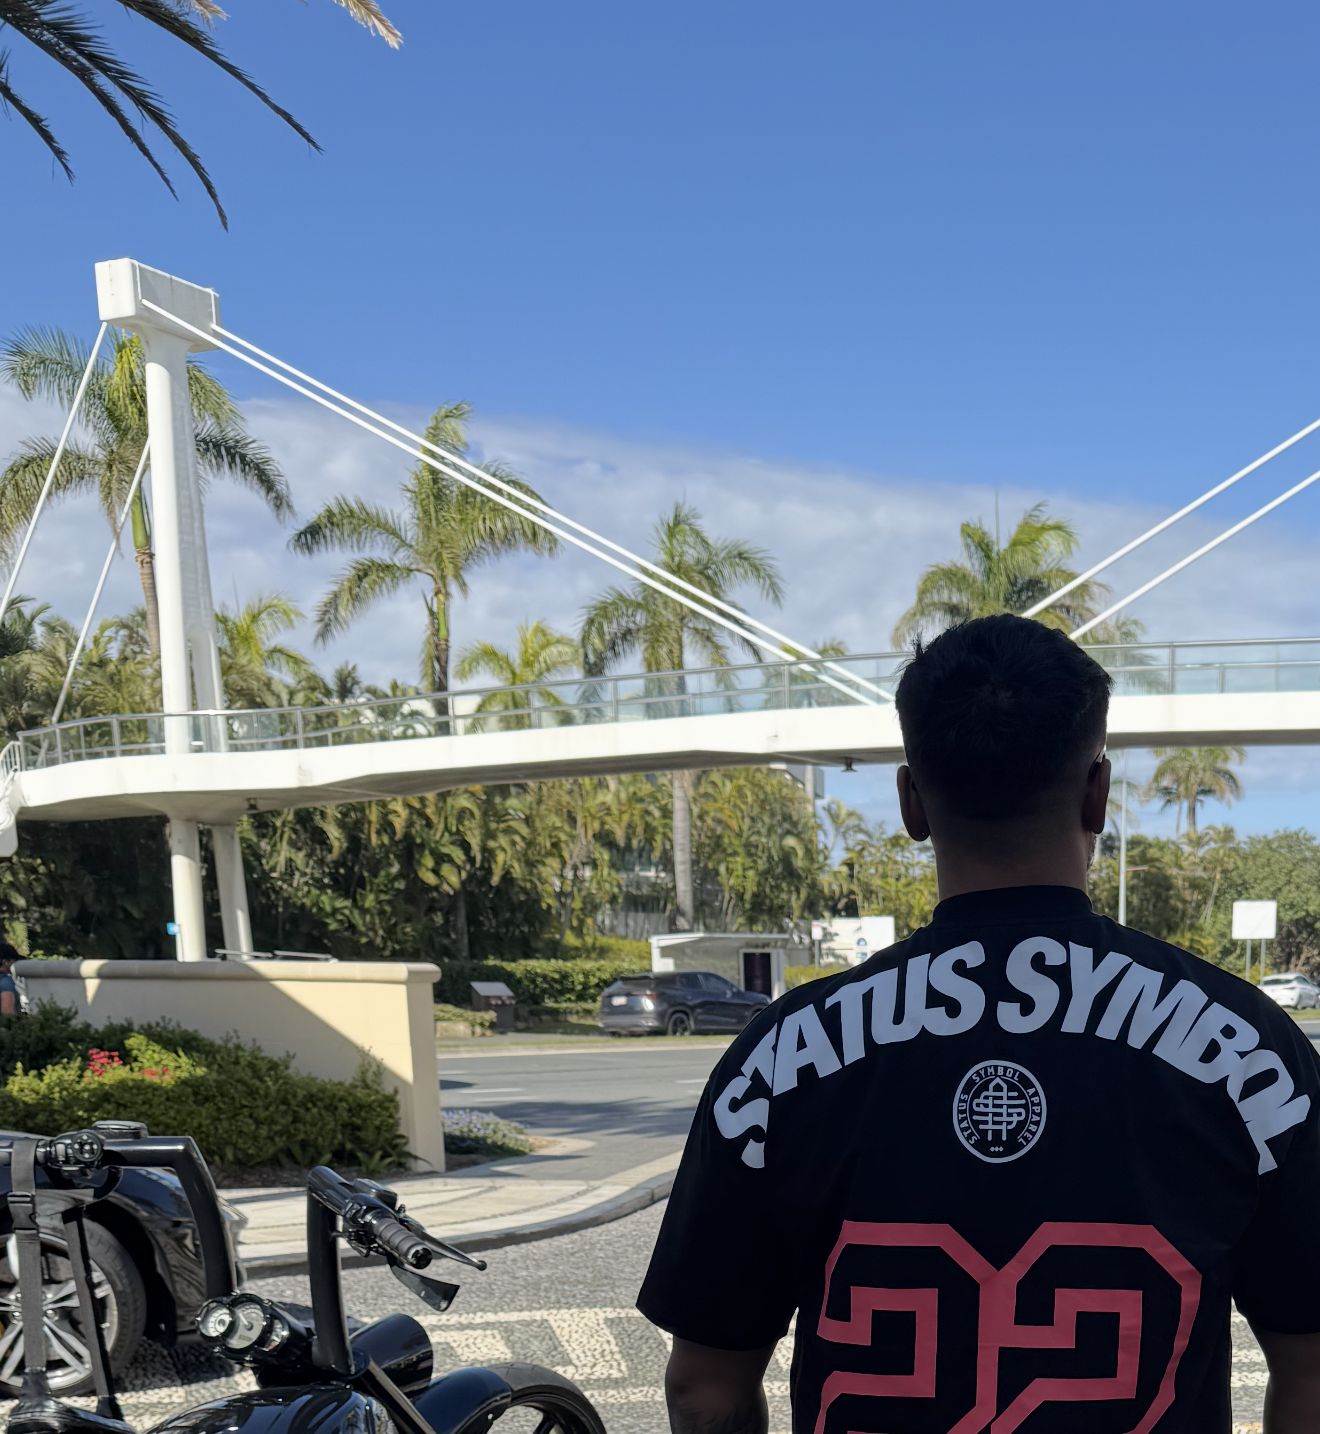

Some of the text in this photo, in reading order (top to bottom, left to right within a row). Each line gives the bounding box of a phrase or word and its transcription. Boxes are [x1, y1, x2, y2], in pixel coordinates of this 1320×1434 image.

[713, 936, 1311, 1176] STATUS SYMBOL
[959, 1093, 977, 1144] STATUS
[972, 1066, 1020, 1082] SYMBOL
[1018, 1087, 1041, 1145] APPAREL
